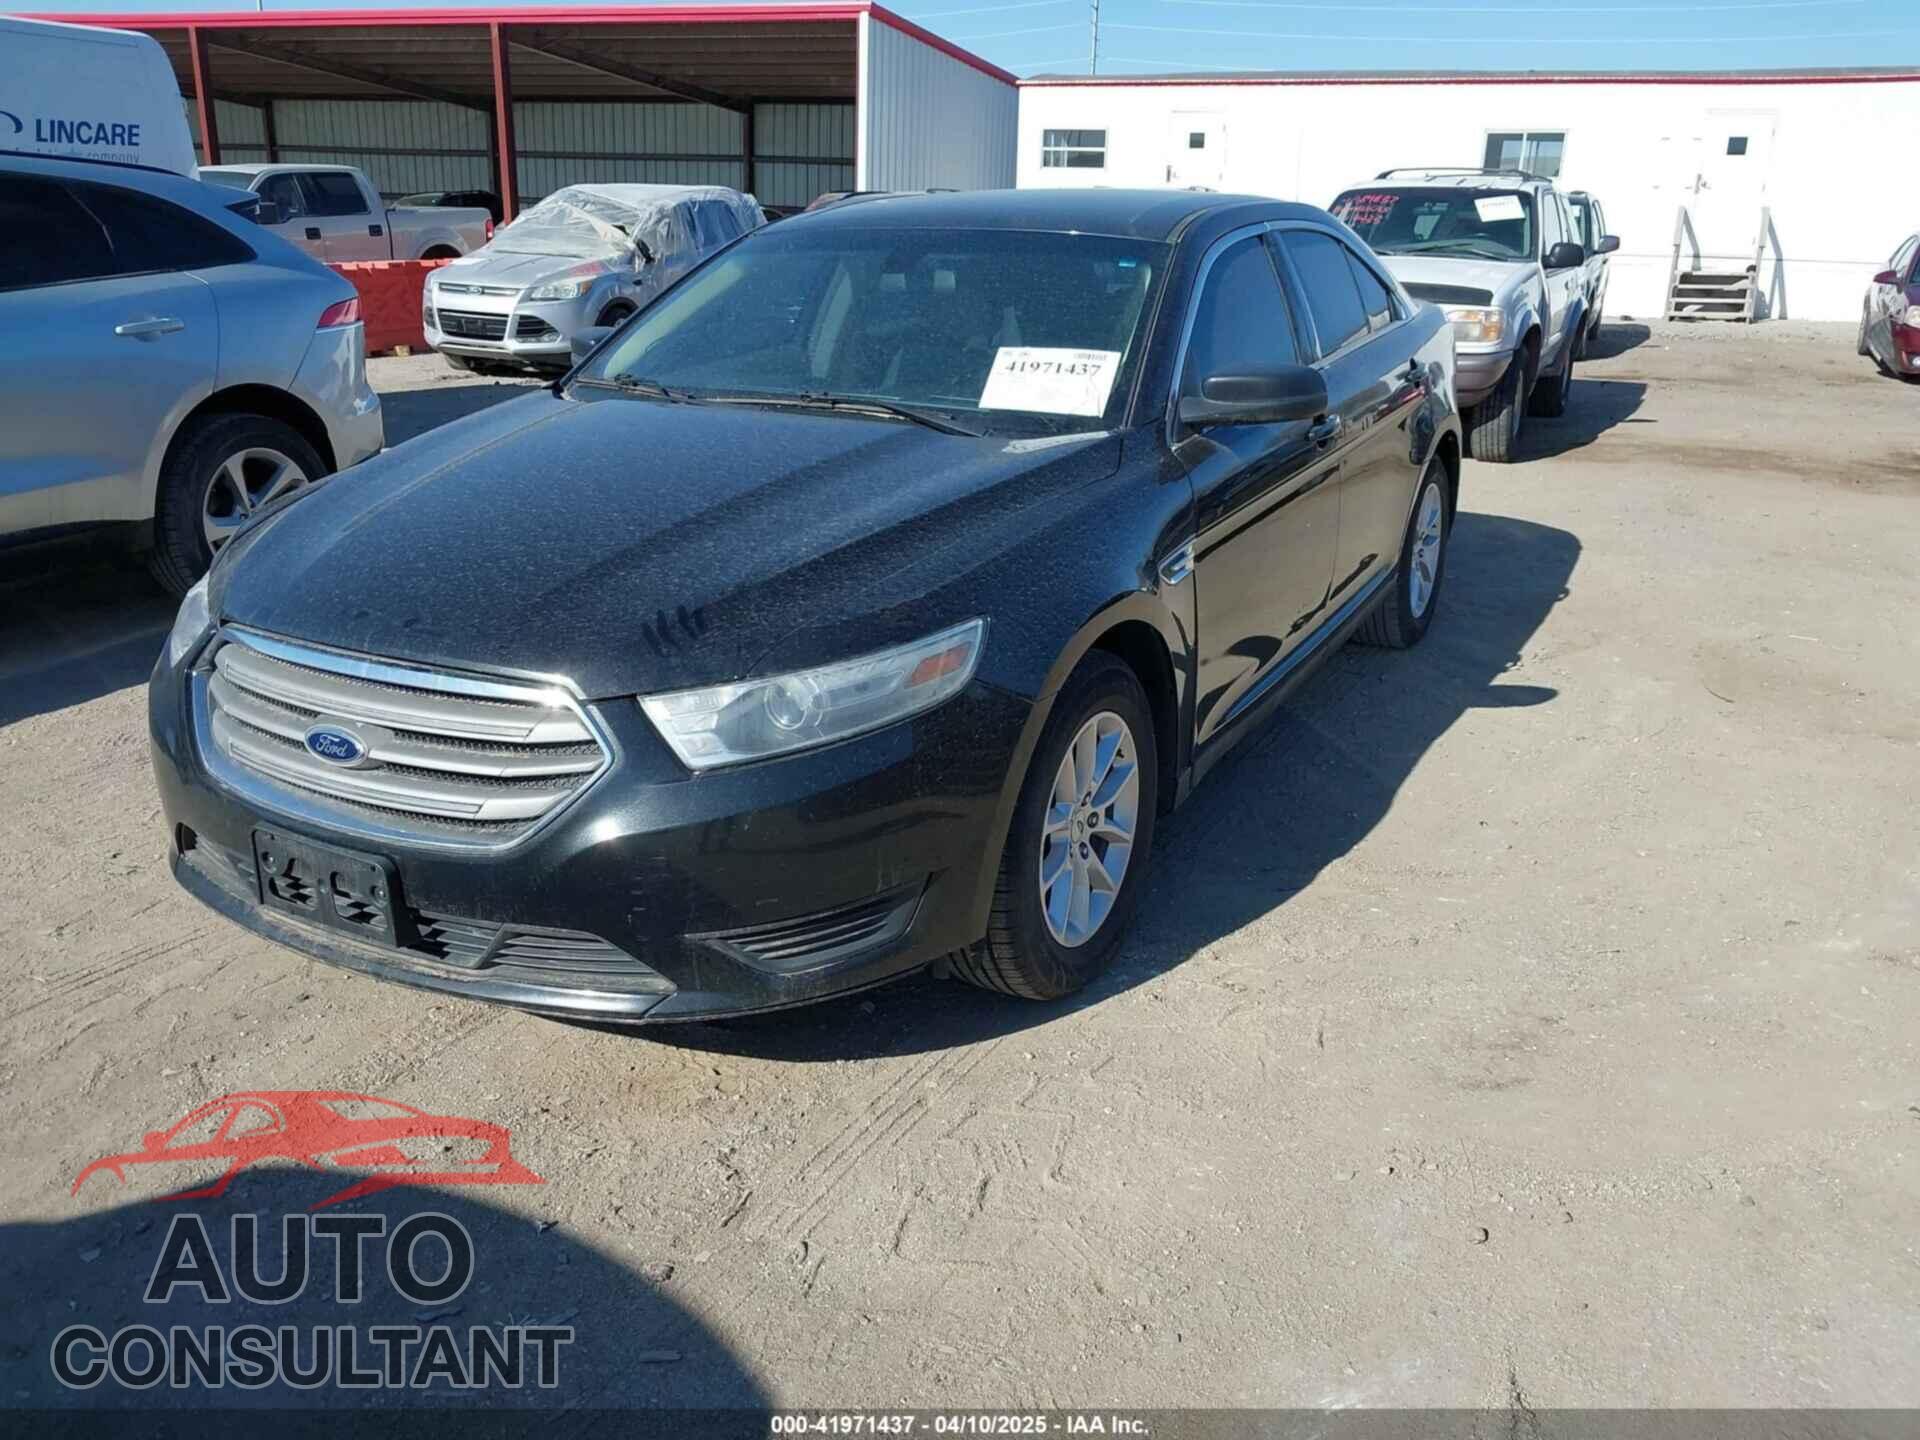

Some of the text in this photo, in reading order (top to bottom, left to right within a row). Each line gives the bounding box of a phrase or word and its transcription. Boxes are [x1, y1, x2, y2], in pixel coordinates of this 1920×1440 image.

[35, 118, 140, 147] LINCARE
[1004, 360, 1101, 377] 41971437
[316, 734, 348, 757] Ford
